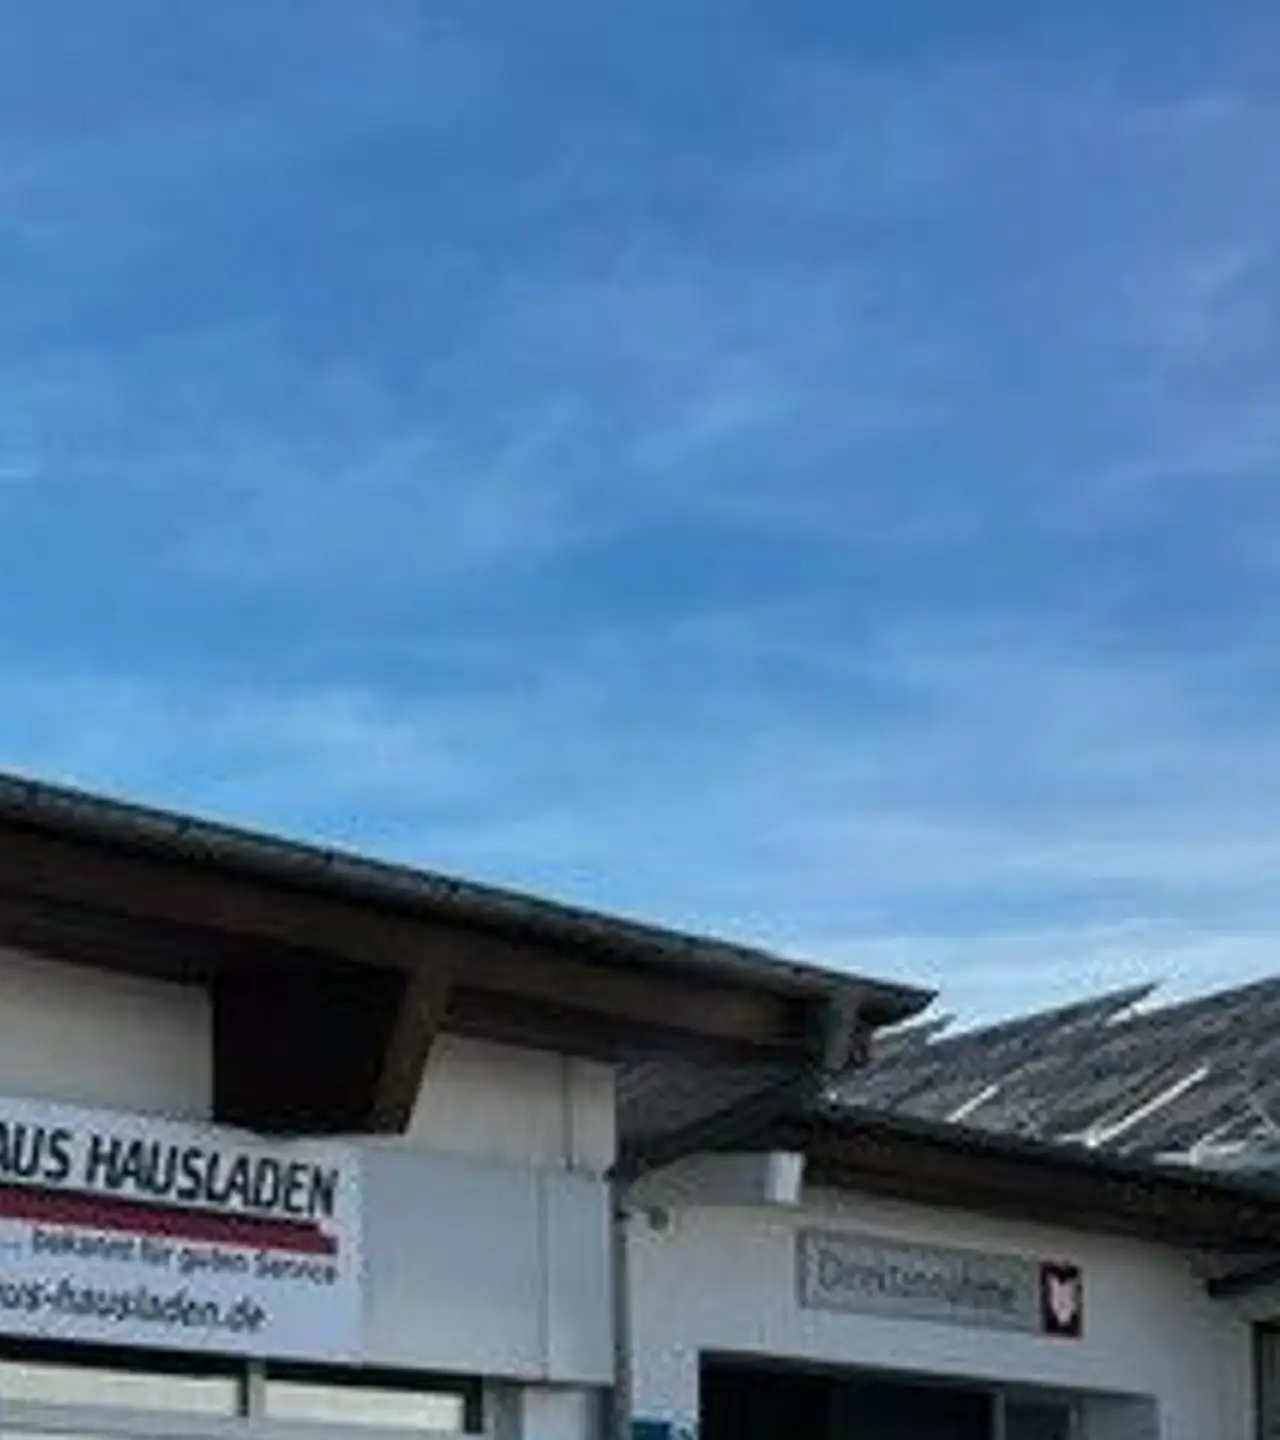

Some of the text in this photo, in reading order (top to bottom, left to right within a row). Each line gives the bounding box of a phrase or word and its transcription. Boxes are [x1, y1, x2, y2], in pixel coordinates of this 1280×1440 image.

[85, 1130, 338, 1216] HAUSLADEN
[32, 1226, 137, 1261] bekannt
[253, 1249, 337, 1287] Service
